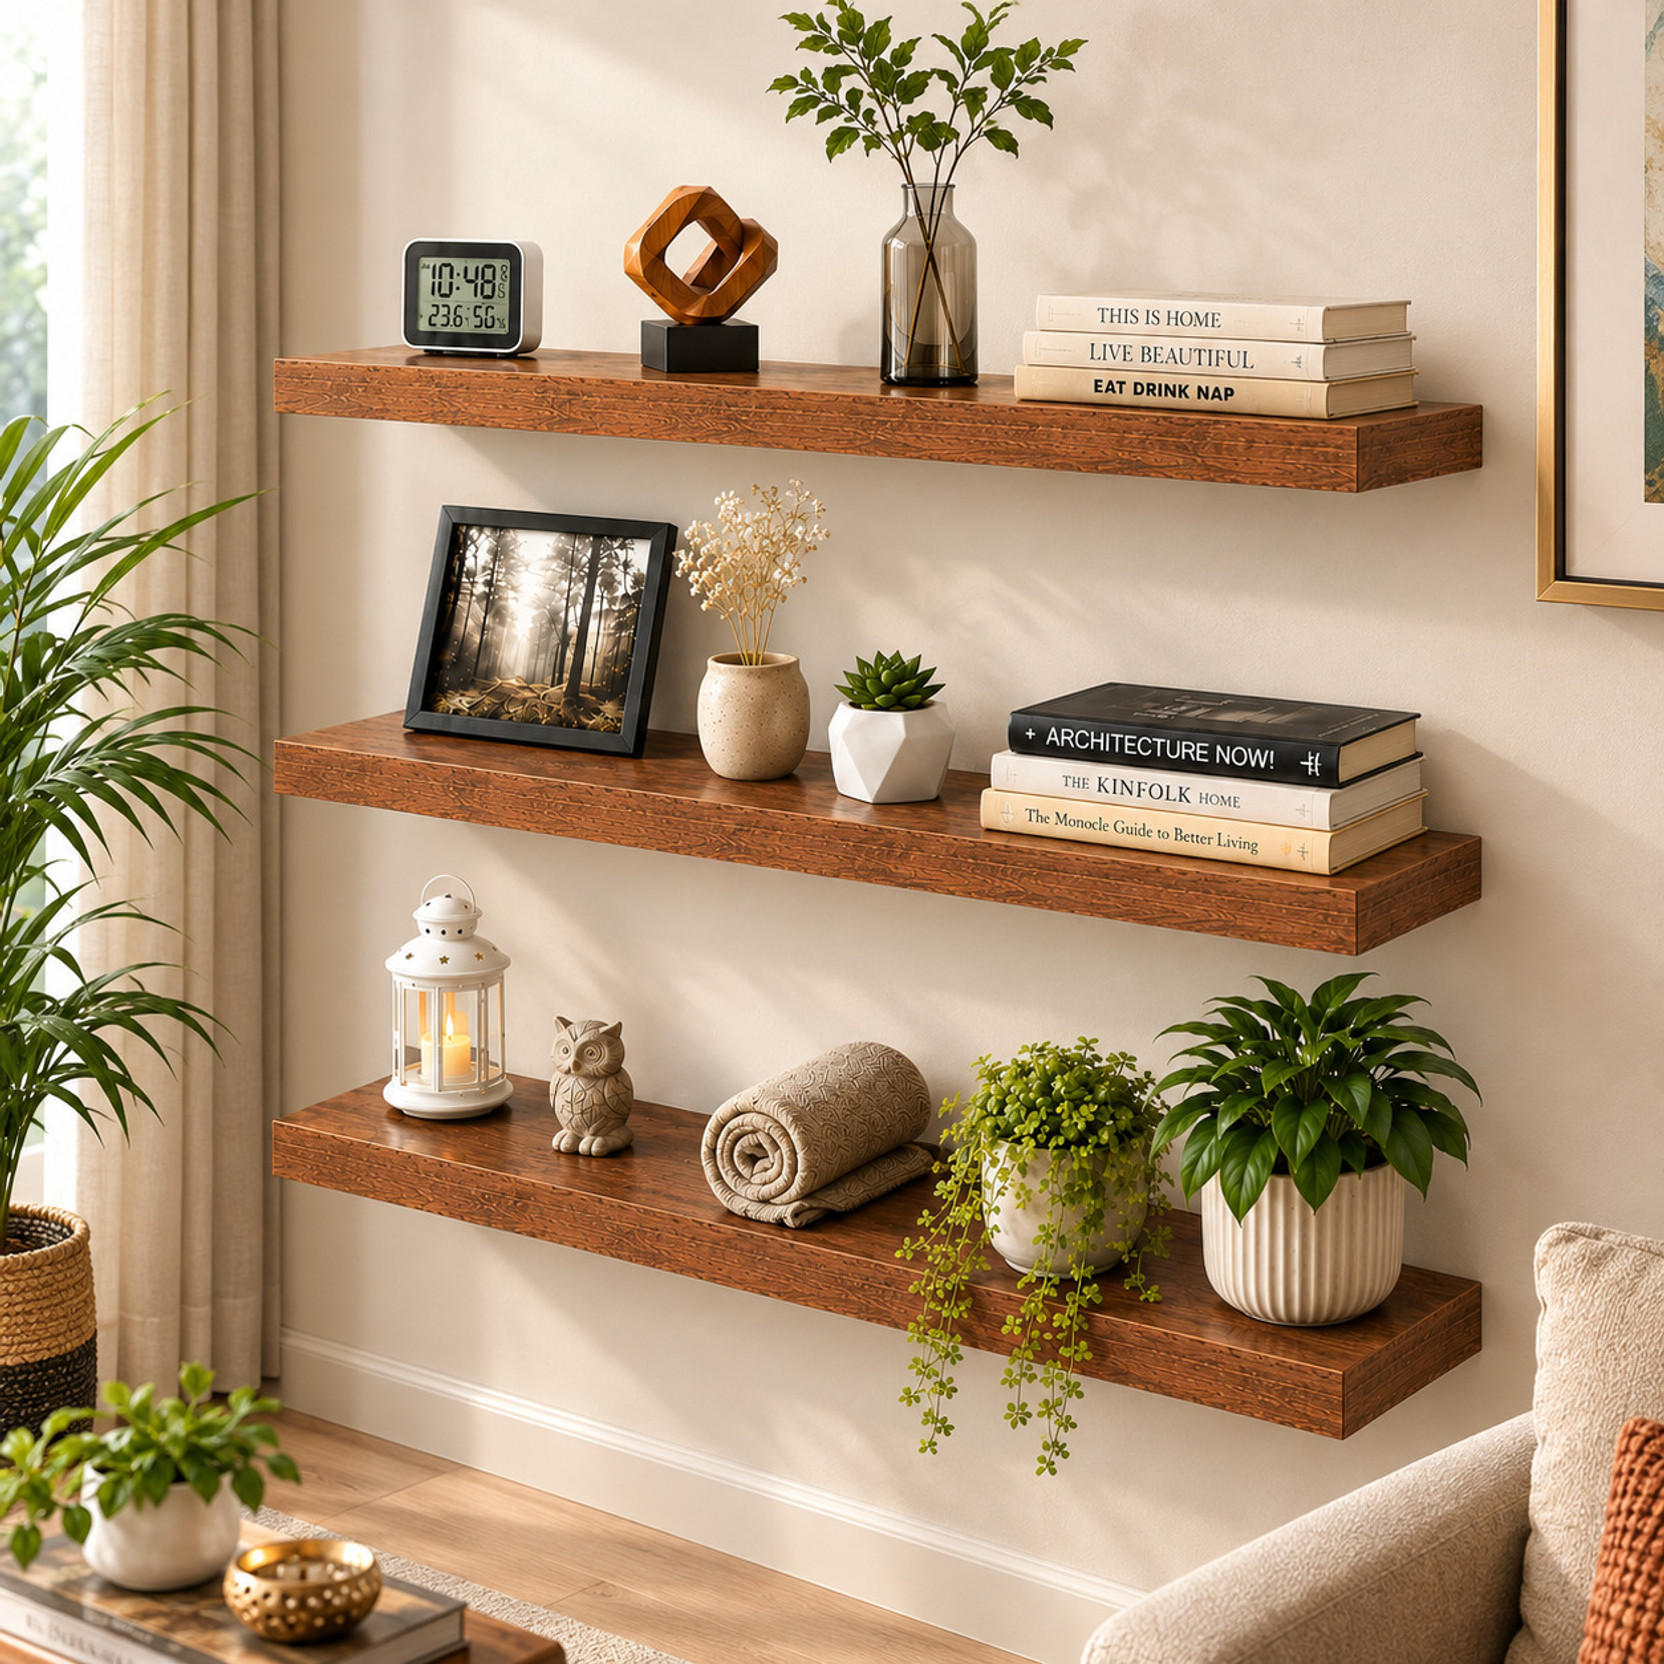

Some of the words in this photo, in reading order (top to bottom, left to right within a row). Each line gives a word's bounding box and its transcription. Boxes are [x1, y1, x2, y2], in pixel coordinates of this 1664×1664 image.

[430, 262, 497, 300] 10:48
[1097, 307, 1139, 325] THIS
[1144, 309, 1161, 326] IS
[1166, 310, 1222, 329] HOME
[1089, 342, 1134, 363] LIVE
[1140, 345, 1255, 370] BEAUTIFUL
[1093, 378, 1127, 395] EAT
[1133, 381, 1190, 400] DRINK
[1196, 384, 1235, 402] NAP
[1045, 726, 1210, 763] ARCHITECTURE
[1215, 744, 1275, 770] NOW!
[1062, 774, 1090, 790] THE
[1097, 776, 1192, 804] KINFOLK
[1199, 792, 1241, 809] HOME
[1024, 807, 1051, 825] The
[1054, 811, 1110, 832] Monocle
[1113, 819, 1154, 838] Guide
[1156, 827, 1170, 840] to
[1174, 826, 1214, 846] Better
[1216, 831, 1259, 856] Living
